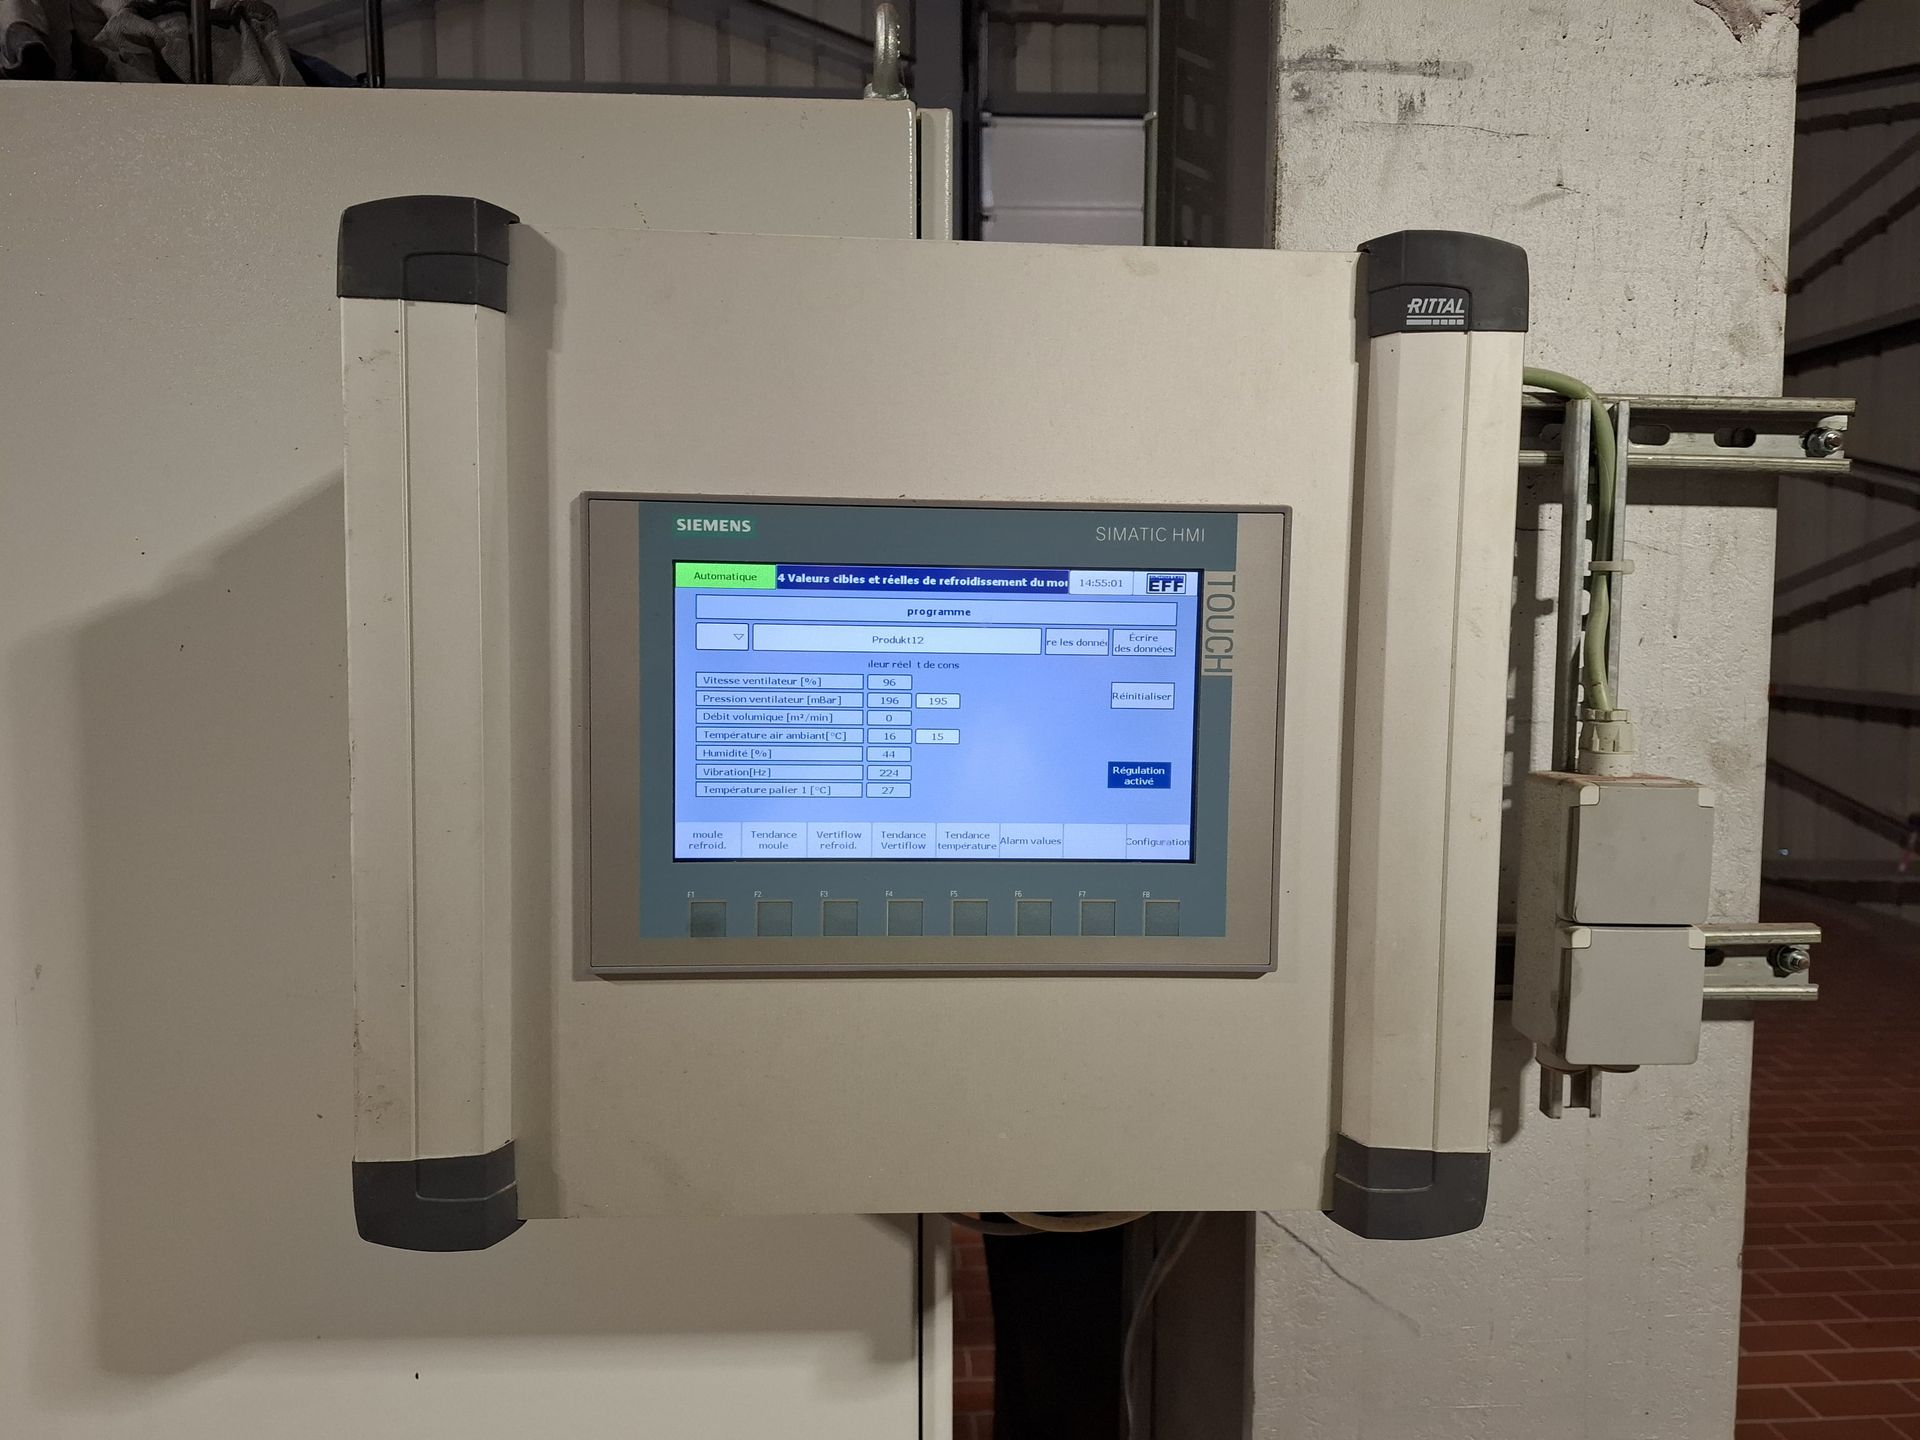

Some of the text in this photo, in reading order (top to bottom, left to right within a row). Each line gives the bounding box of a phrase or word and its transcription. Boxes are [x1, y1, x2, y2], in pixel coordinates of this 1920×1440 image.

[1407, 298, 1465, 314] RITTAL
[676, 519, 751, 533] SIEMENS
[1096, 526, 1205, 542] SIMATIC HMI
[694, 571, 757, 583] Automatique
[777, 573, 785, 583] 4
[788, 573, 830, 584] Valeurs
[833, 574, 865, 584] cibles
[868, 575, 880, 584] et
[882, 574, 919, 585] réelles
[922, 576, 936, 585] de
[939, 576, 1027, 587] refroidissement
[1030, 577, 1044, 587] du
[1079, 578, 1123, 588] 14:55:01
[1149, 580, 1184, 592] EFF
[907, 607, 971, 618] programme
[1204, 574, 1236, 673] TOUCH
[872, 635, 925, 645] Produkt12
[1129, 632, 1159, 642] Écrire
[1060, 638, 1074, 646] les
[1114, 644, 1174, 653] des données
[923, 661, 935, 669] de
[703, 676, 822, 688] Vitesse ventilateur [%]
[883, 678, 896, 687] 96
[703, 695, 842, 706] Pression ventilateur [mBar]
[1112, 691, 1172, 701] Réinitialiser
[881, 697, 899, 706] 196
[929, 697, 948, 706] 195
[703, 712, 730, 722] Débit
[732, 713, 784, 725] volumique
[885, 714, 893, 723] 0
[704, 730, 767, 741] Température
[769, 731, 784, 740] air
[884, 732, 896, 741] 16
[931, 732, 944, 741] 15
[702, 748, 772, 759] Humidité [%]
[882, 750, 896, 759] 44
[703, 768, 771, 778] Vibration[Hz]
[879, 769, 899, 778] 224
[1112, 765, 1165, 777] Régulation
[1124, 776, 1154, 786] activé
[704, 786, 767, 797] Température
[769, 786, 799, 797] palier
[802, 787, 807, 795] 1
[882, 786, 895, 795] 27
[692, 830, 723, 838] moule
[750, 830, 797, 839] Tendance
[816, 830, 862, 839] Vertiflow
[880, 830, 927, 839] Tendance
[945, 831, 990, 840] Tendance
[688, 840, 727, 850] refroid.
[758, 841, 789, 850] moule
[820, 841, 857, 850] refroid.
[880, 841, 926, 850] Vertiflow
[1000, 836, 1062, 846] Alarm values
[937, 842, 997, 852] température
[687, 890, 695, 898] F1
[754, 890, 762, 898] F2
[820, 890, 828, 898] F3
[885, 890, 893, 898] F4
[950, 890, 958, 898] F5
[1014, 890, 1022, 898] F6
[1078, 890, 1086, 898] F7
[1142, 890, 1150, 898] F8
